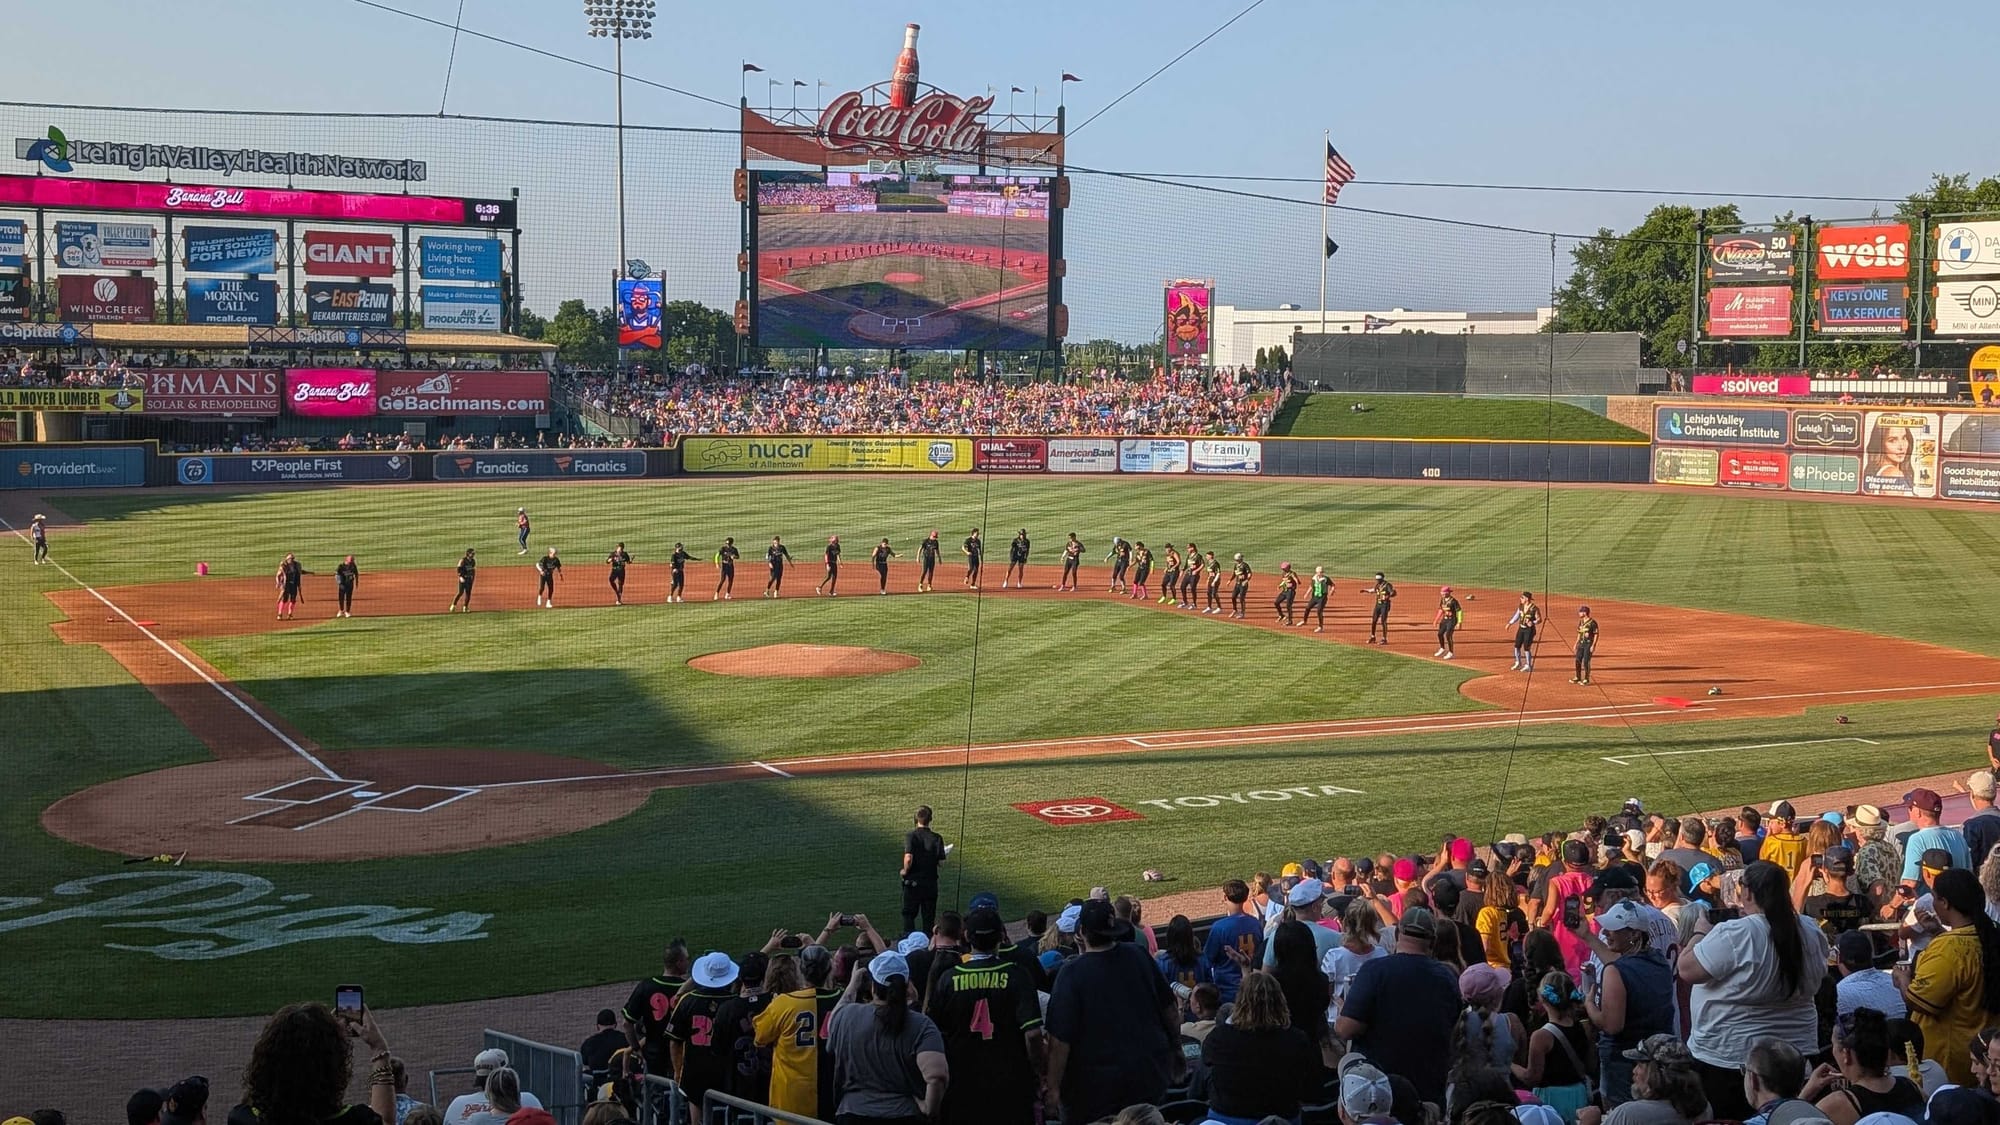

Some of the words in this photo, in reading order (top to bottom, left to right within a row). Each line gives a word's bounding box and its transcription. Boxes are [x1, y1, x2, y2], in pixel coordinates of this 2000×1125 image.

[820, 92, 995, 155] Coca-Cola
[166, 187, 213, 208] Banana
[210, 191, 244, 209] Ball
[474, 203, 501, 215] 6:38
[190, 244, 224, 254] FIRST
[225, 240, 272, 250] SOURCE
[428, 241, 463, 253] Working
[464, 243, 486, 252] here.
[1771, 236, 1787, 250] 50
[190, 251, 224, 263] FOR
[226, 246, 273, 259] NEWS
[308, 243, 391, 264] GIANT
[1766, 250, 1791, 259] Years!
[1820, 234, 1906, 269] weis
[428, 253, 452, 264] Living
[453, 255, 476, 264] here.
[428, 265, 456, 276] Giving
[456, 267, 478, 276] here.
[219, 280, 244, 292] THE
[204, 290, 260, 303] MORNING
[1830, 288, 1889, 301] KEYSTONE
[217, 301, 248, 312] CALL
[1972, 297, 1995, 306] MINI
[70, 304, 103, 314] WIND
[105, 306, 142, 315] CREEK
[460, 309, 477, 317] AIR
[1830, 307, 1852, 319] TAX
[1854, 307, 1901, 320] SERVICE
[206, 314, 258, 324] mcall.com
[312, 311, 387, 322] DEKABATTERIES.COM
[429, 315, 477, 324] PRODUCTS
[2, 325, 60, 340] Capital
[1952, 322, 1969, 330] MINI
[1970, 322, 1979, 330] of
[294, 383, 338, 401] Banana
[337, 382, 371, 402] Ball
[391, 385, 416, 397] Let's
[20, 391, 56, 406] MOYER
[58, 391, 100, 406] LUMBER
[147, 400, 185, 410] SOLAR
[188, 400, 199, 410] &
[201, 400, 278, 410] REMODELING
[378, 396, 546, 412] GoBachmans.com
[1684, 413, 1717, 425] Lehigh
[1716, 415, 1746, 427] Valley
[1683, 424, 1738, 439] Orthopedic
[1739, 426, 1781, 442] Institute
[1797, 424, 1823, 433] Lehigh
[1831, 424, 1855, 435] Valley
[748, 442, 813, 459] nucar
[928, 446, 939, 457] 20
[980, 442, 1006, 452] DUAL
[1049, 447, 1116, 459] AmericanBank
[1213, 444, 1251, 456] Family
[34, 461, 96, 476] Provident
[187, 464, 204, 477] 75
[267, 459, 311, 476] People
[314, 458, 343, 472] First
[475, 461, 529, 475] Fanatics
[573, 459, 627, 474] Fanatics
[749, 461, 758, 469] of
[761, 461, 804, 469] Allentown
[1943, 466, 1965, 475] Good
[1422, 467, 1440, 478] 400
[1806, 465, 1856, 482] Phoebe
[1865, 475, 1898, 484] Discover
[1138, 784, 1369, 811] TOYOTA
[952, 972, 1009, 992] THOMAS
[970, 998, 994, 1039] 4
[795, 1011, 816, 1048] 2
